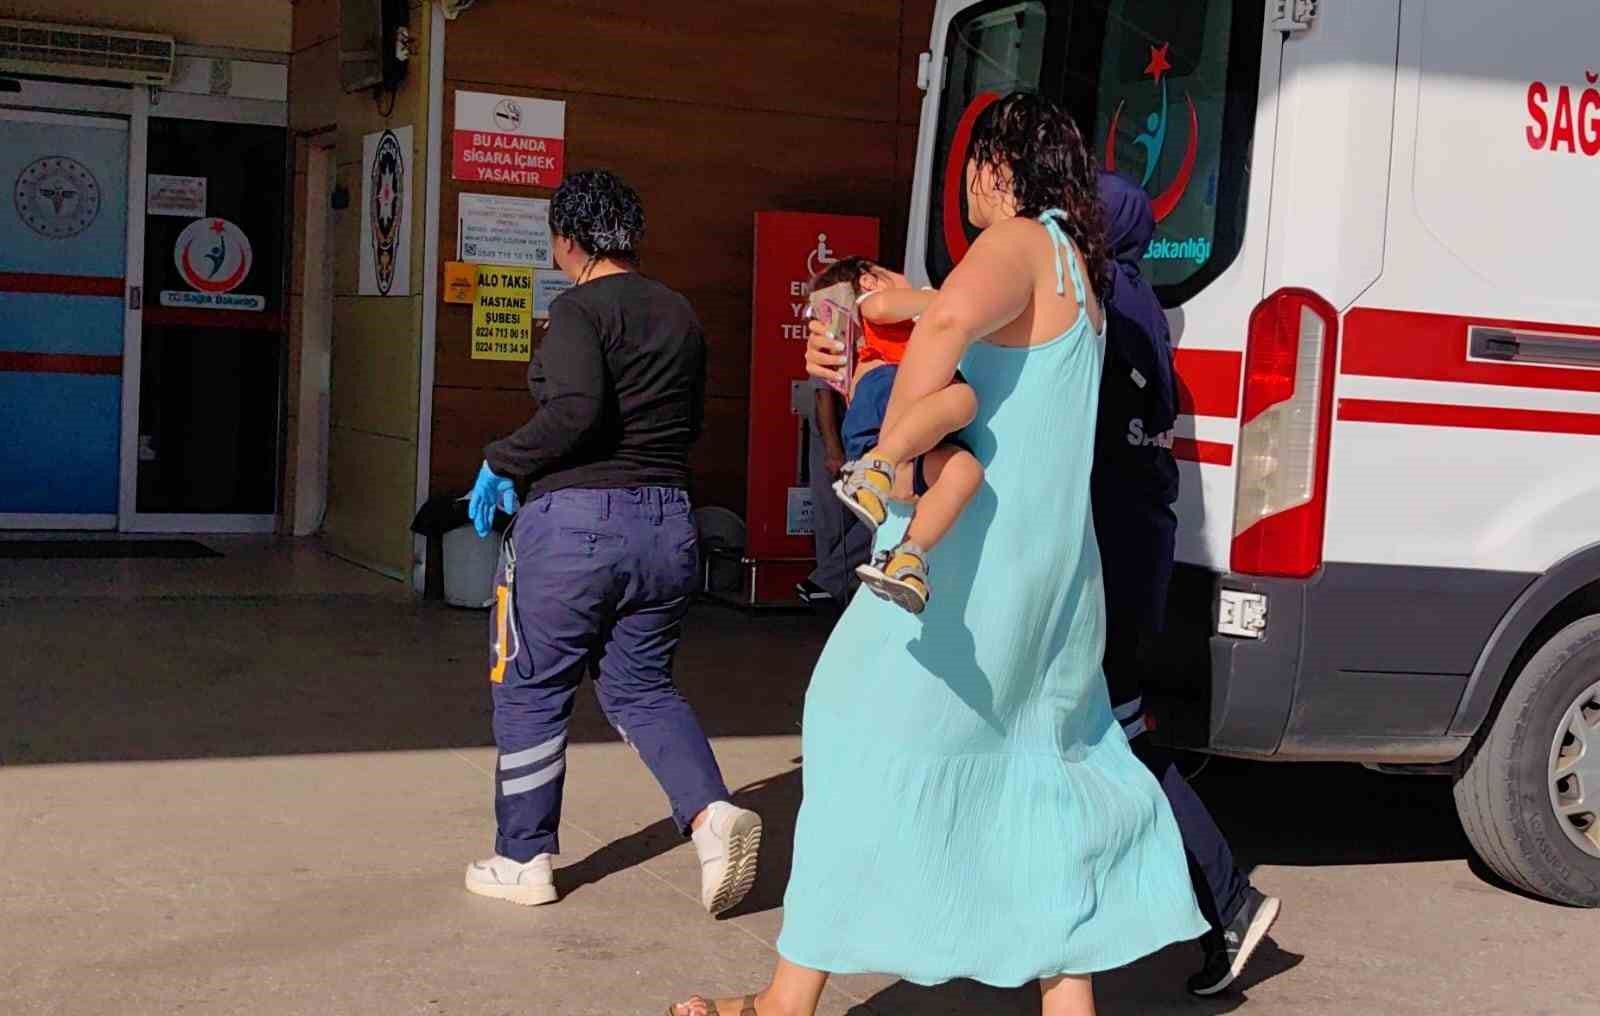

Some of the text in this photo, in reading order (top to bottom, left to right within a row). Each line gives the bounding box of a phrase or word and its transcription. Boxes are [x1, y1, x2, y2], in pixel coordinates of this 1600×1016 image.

[473, 134, 546, 152] BU ALANDA
[463, 148, 555, 169] SİGARA İÇMEK
[478, 167, 540, 185] YASAKTIR
[478, 274, 498, 288] ALO
[481, 296, 526, 309] HASTANE
[475, 326, 493, 338] 0224
[781, 324, 809, 339] TEL
[475, 341, 493, 352] 0224
